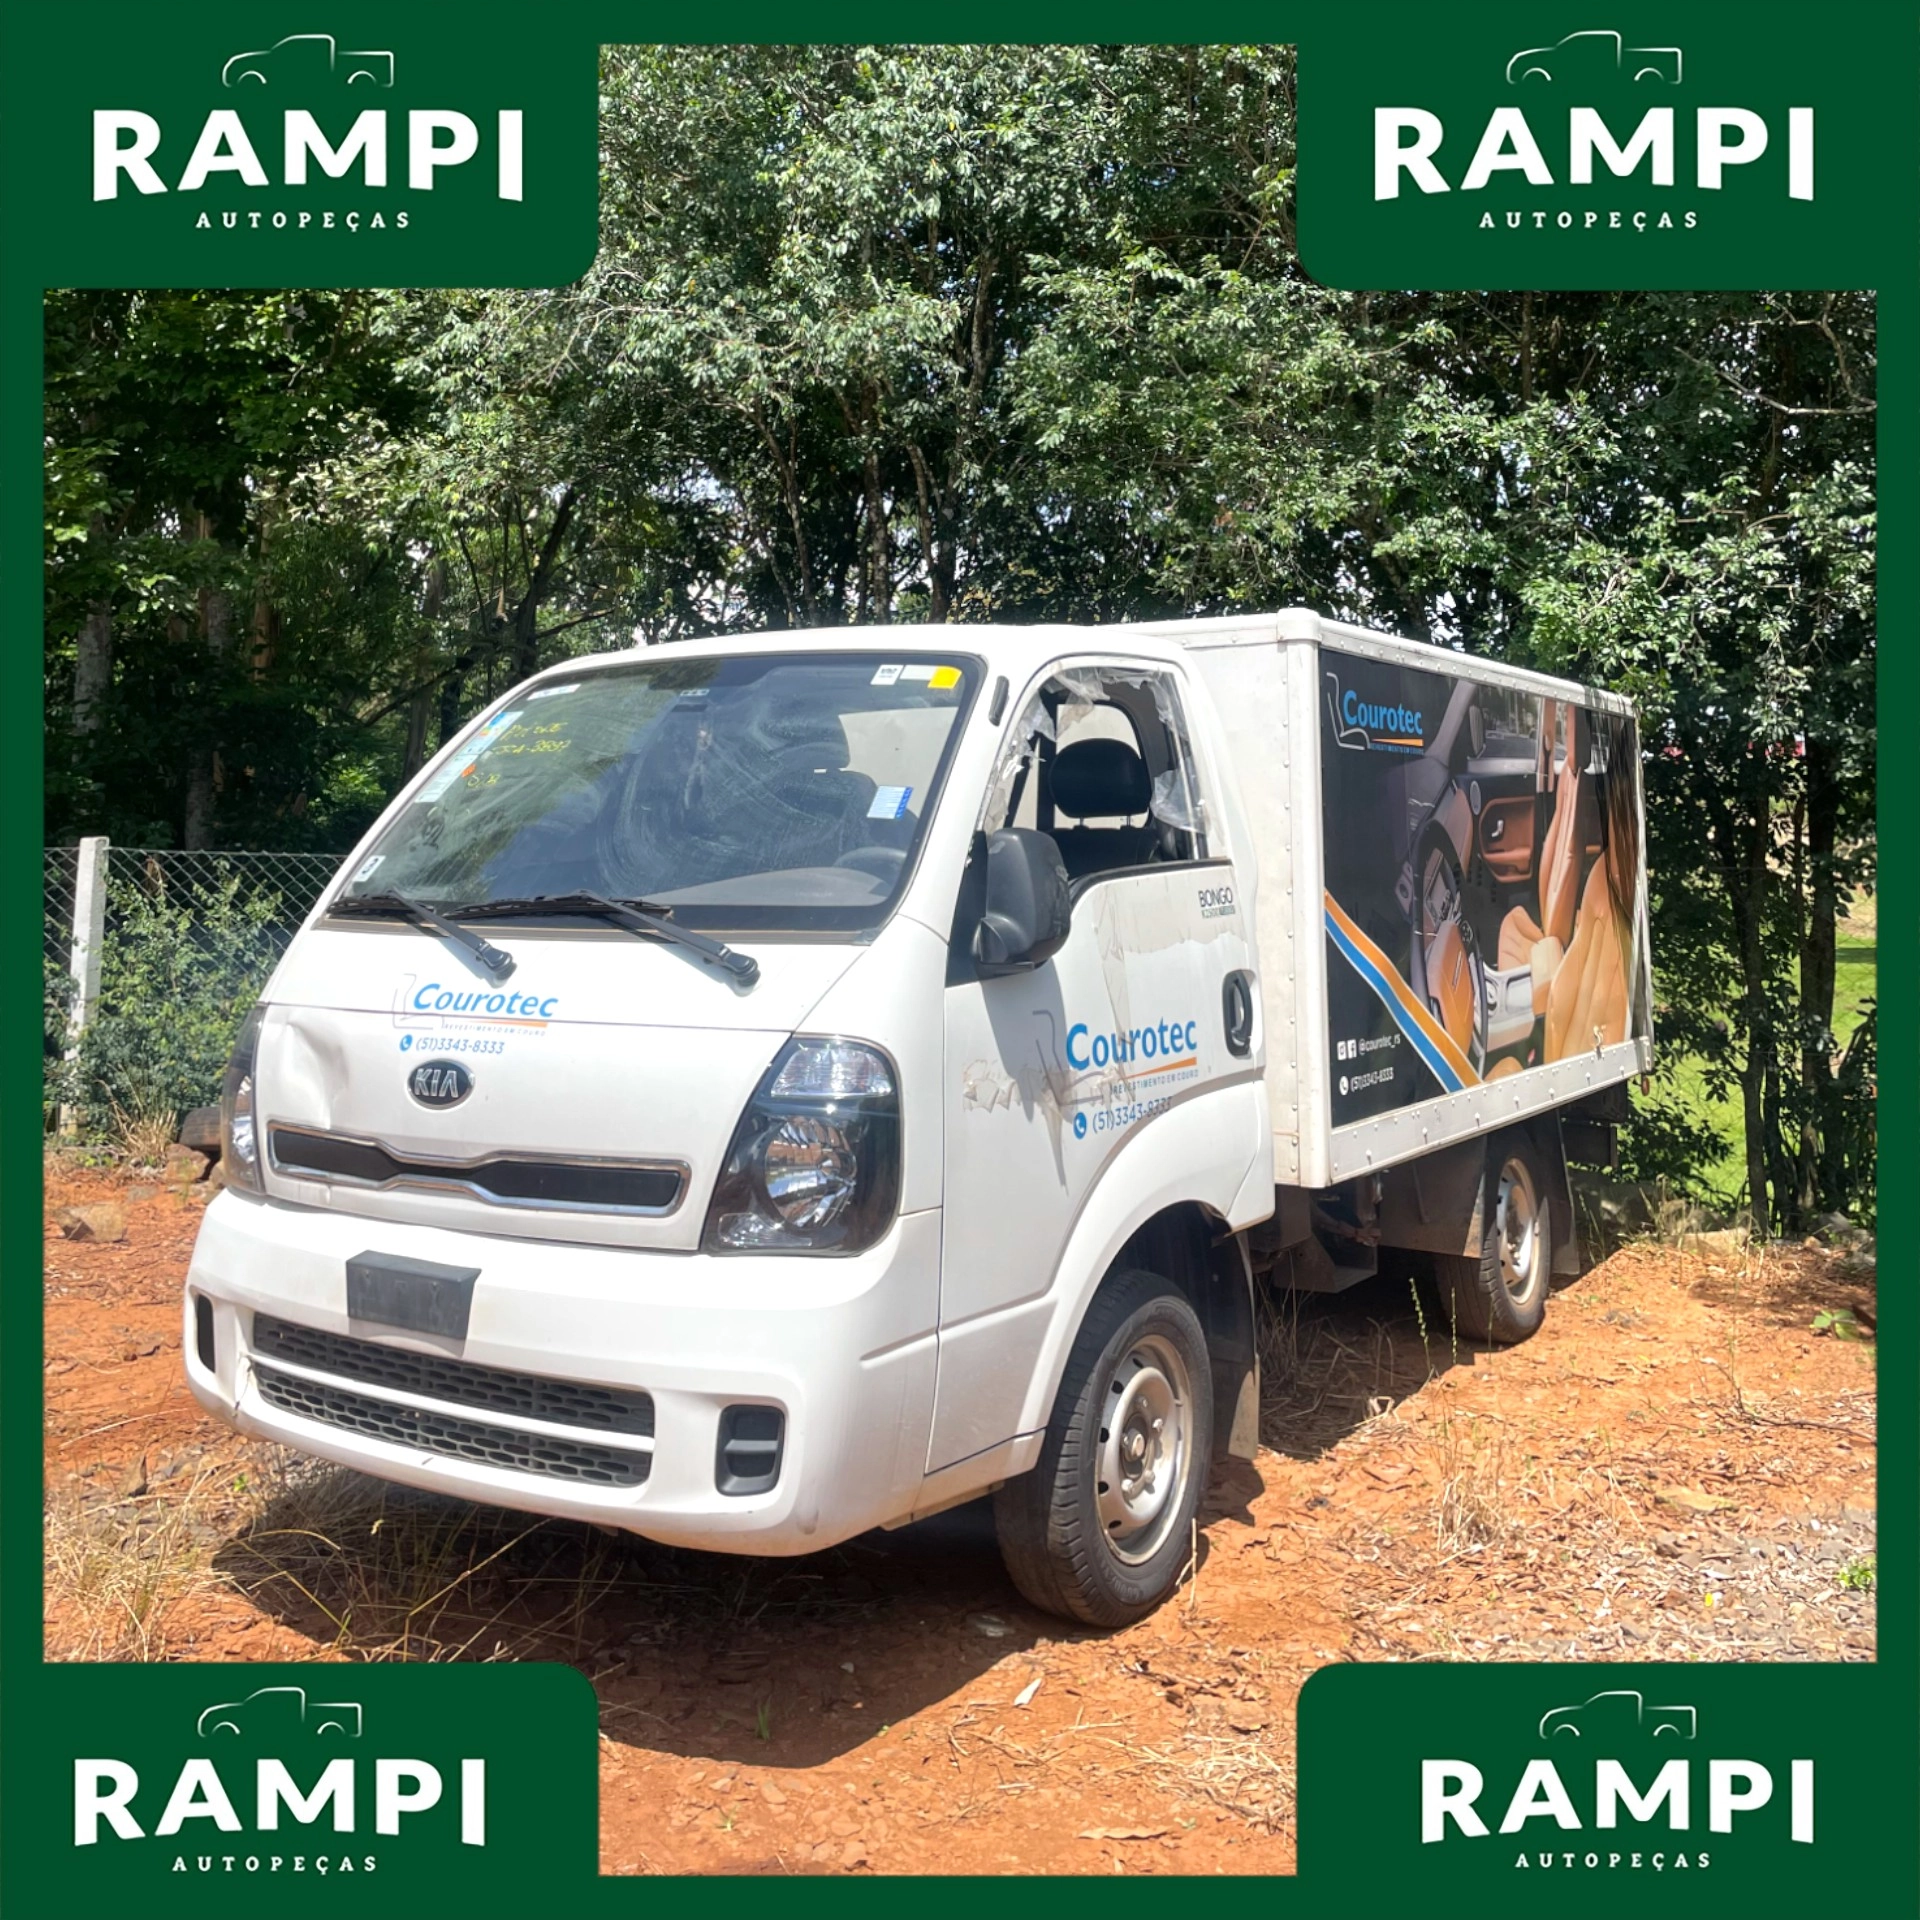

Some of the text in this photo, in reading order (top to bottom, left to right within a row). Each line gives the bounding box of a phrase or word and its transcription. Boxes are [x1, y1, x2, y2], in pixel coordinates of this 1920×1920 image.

[1343, 690, 1423, 735] Courotec
[1198, 887, 1233, 907] BONGO
[413, 983, 559, 1017] Courotec
[415, 1037, 505, 1054] (51)3343-8333
[1066, 1016, 1198, 1071] Courotec
[414, 1068, 459, 1098] KIA
